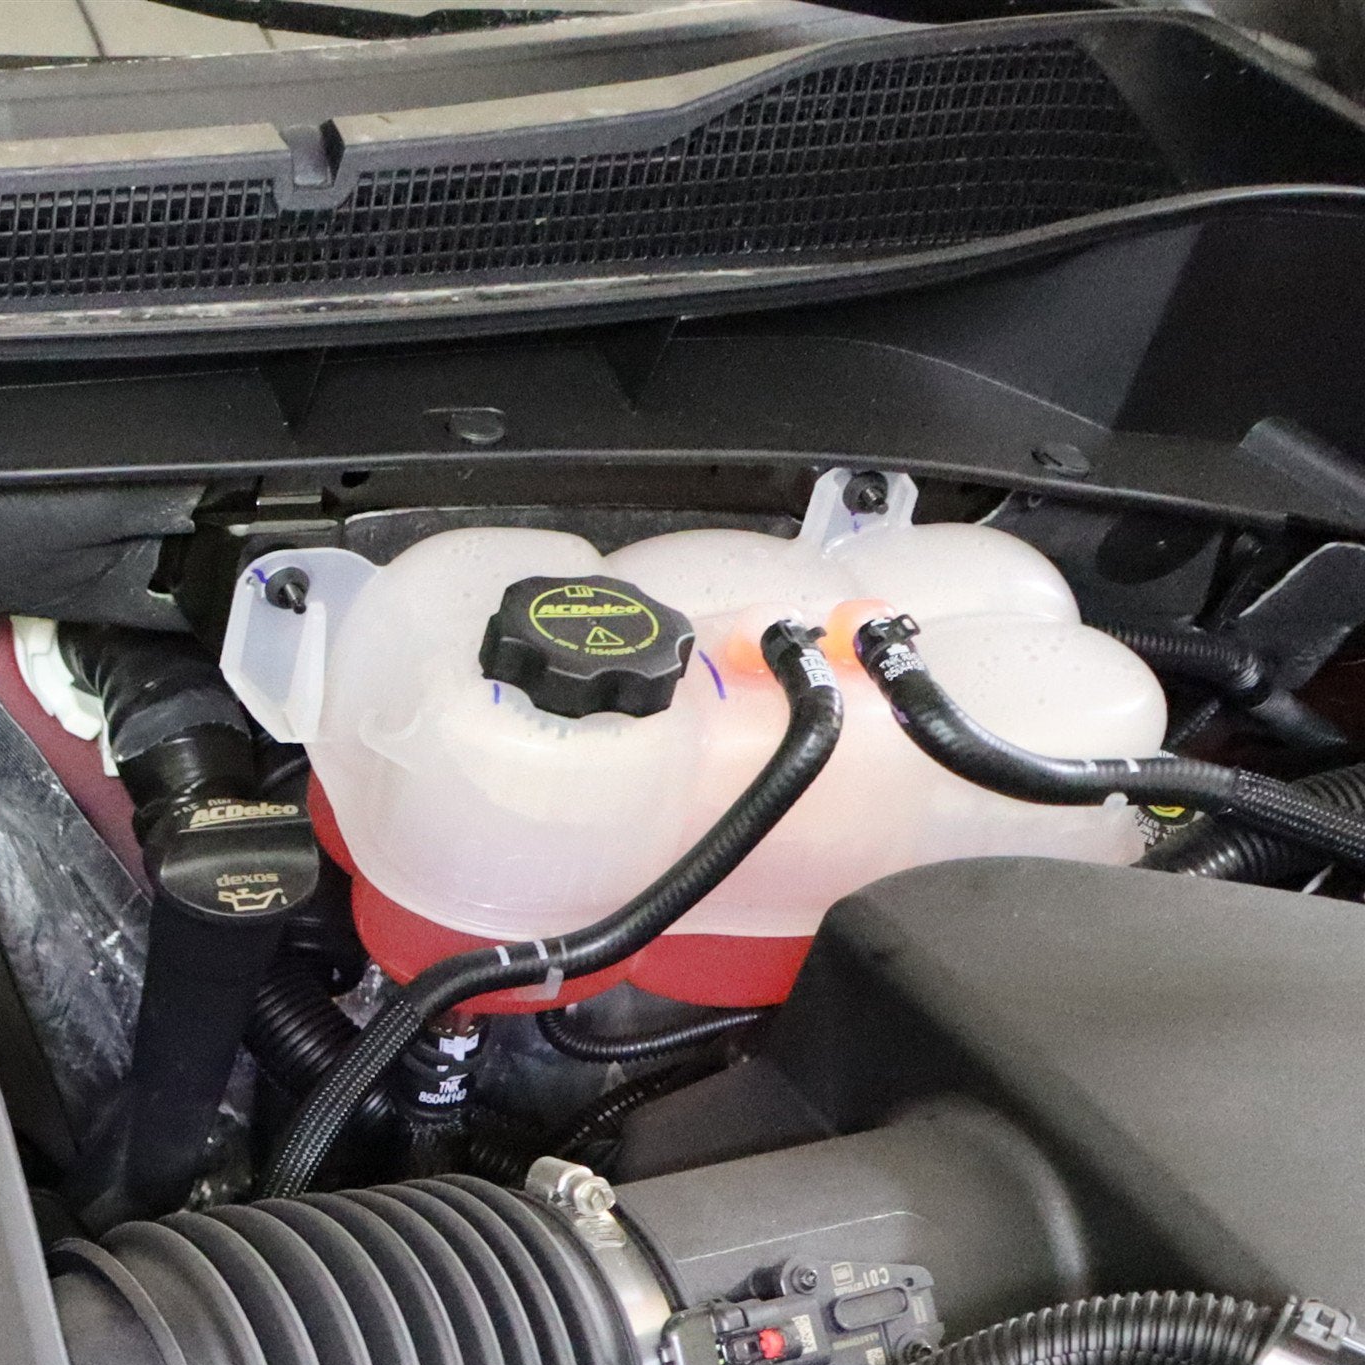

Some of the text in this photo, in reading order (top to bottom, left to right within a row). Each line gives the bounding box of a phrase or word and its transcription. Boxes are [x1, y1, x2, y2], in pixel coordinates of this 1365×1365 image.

[537, 603, 643, 615] ACDelco
[189, 802, 299, 824] ACDelco
[216, 873, 279, 887] dexos
[439, 1079, 462, 1094] TNK
